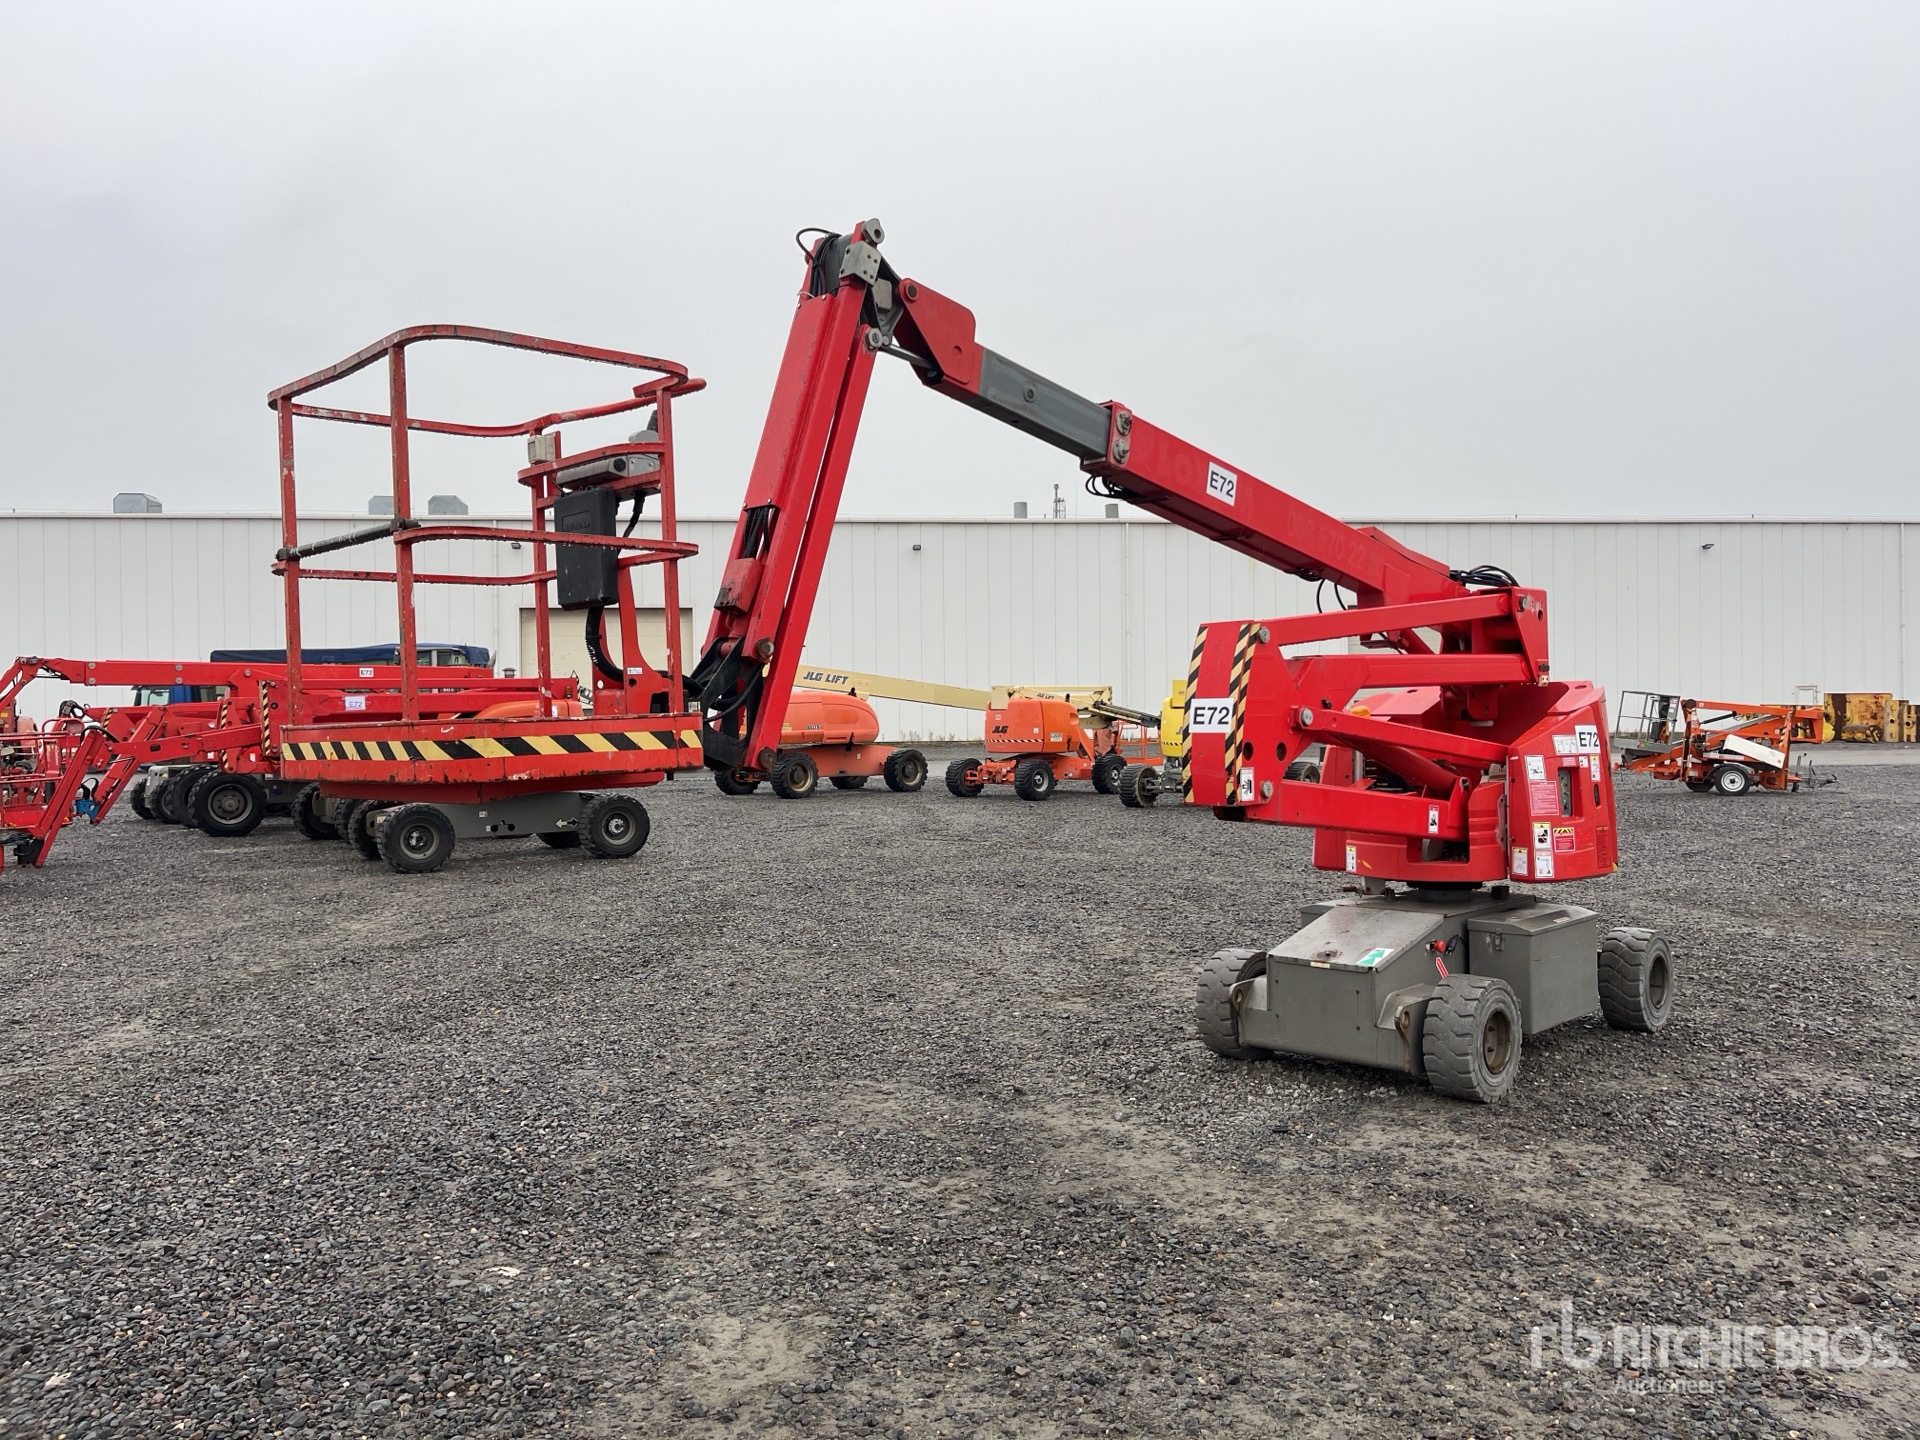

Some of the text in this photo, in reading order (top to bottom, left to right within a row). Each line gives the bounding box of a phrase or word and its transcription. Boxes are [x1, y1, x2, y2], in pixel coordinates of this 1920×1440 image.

[1209, 470, 1235, 498] E72
[803, 671, 849, 685] JLG LIFT
[1192, 706, 1230, 725] E72
[992, 725, 1009, 734] JLG
[1578, 731, 1599, 747] E72
